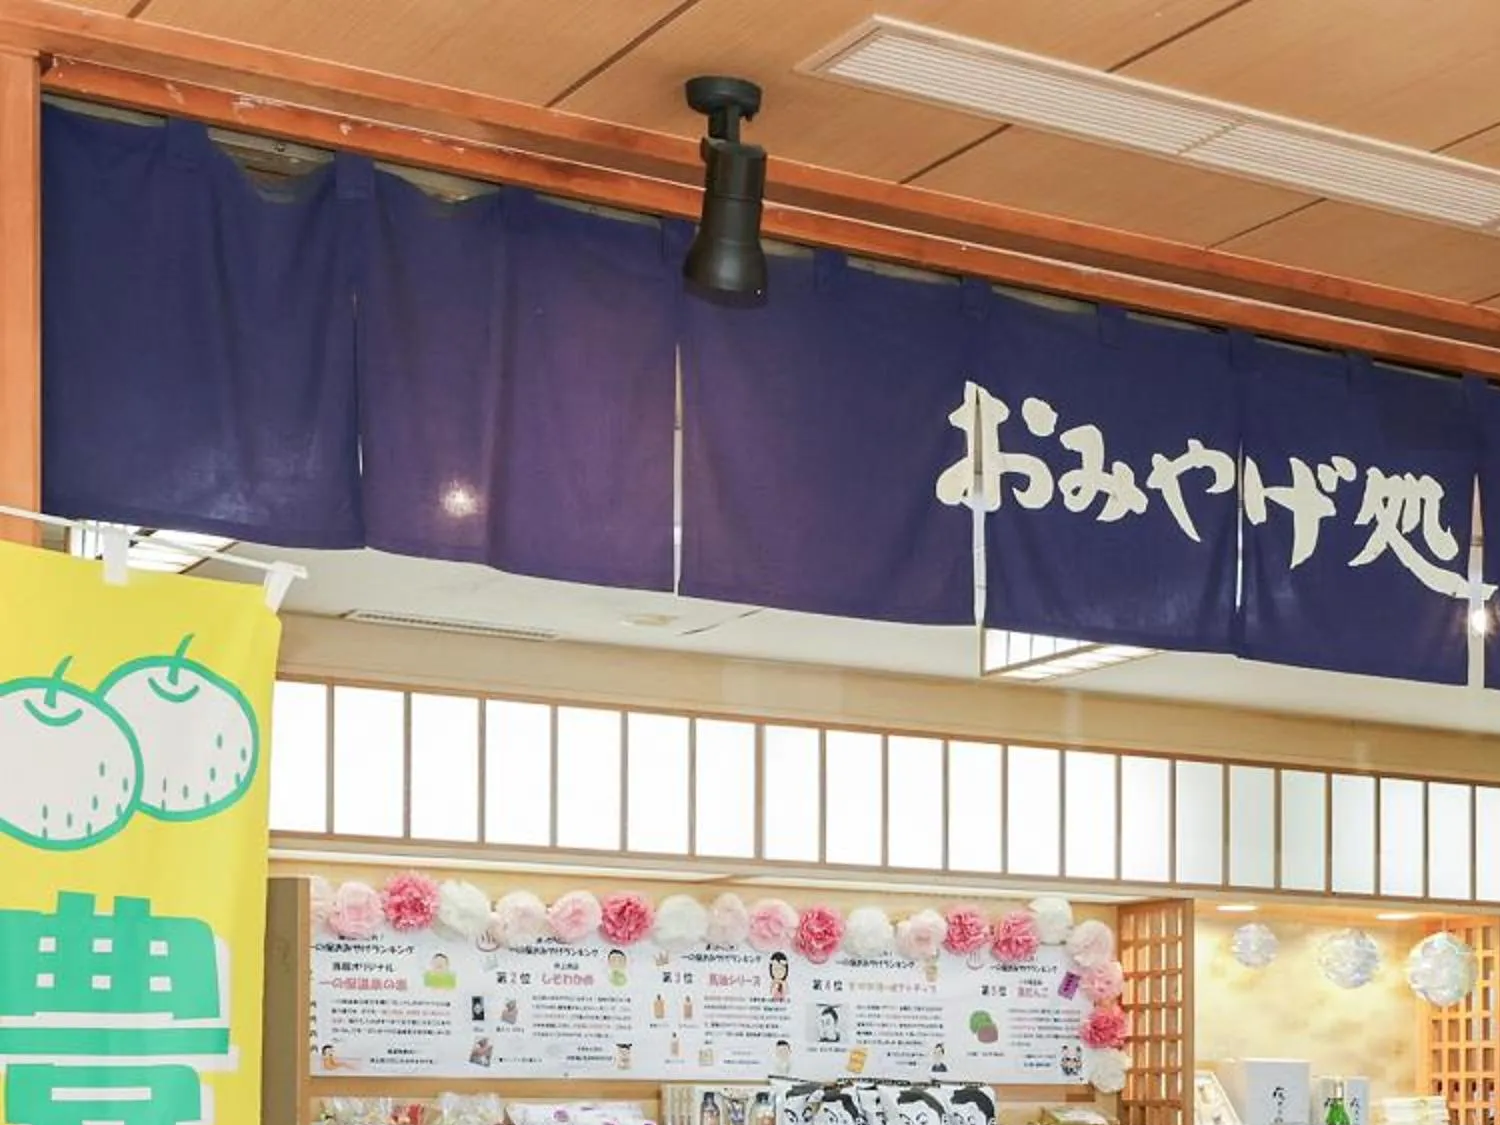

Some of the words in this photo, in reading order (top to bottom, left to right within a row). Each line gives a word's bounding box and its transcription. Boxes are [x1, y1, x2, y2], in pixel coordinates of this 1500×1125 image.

[937, 381, 1498, 600] おみやげ処
